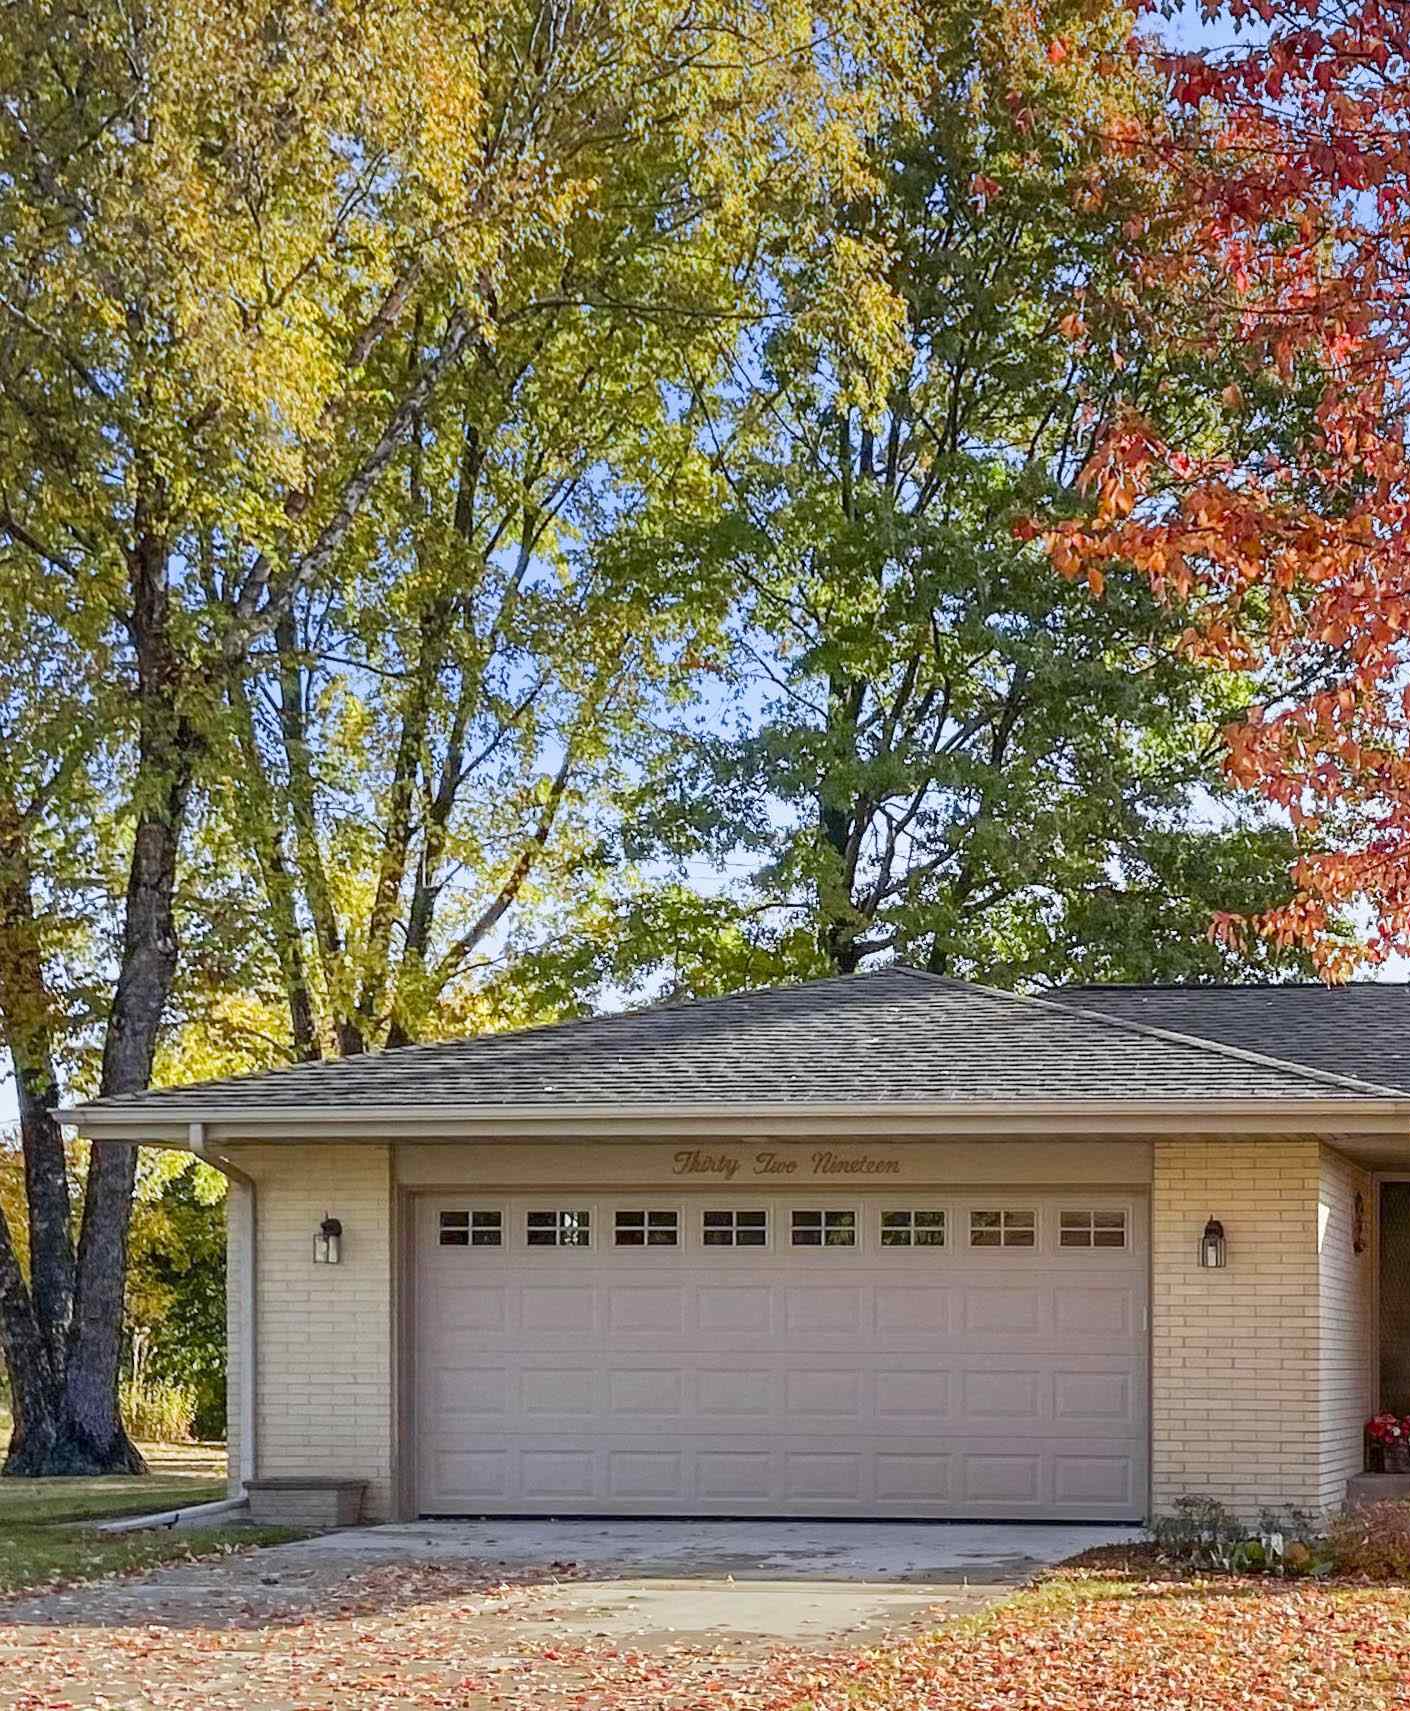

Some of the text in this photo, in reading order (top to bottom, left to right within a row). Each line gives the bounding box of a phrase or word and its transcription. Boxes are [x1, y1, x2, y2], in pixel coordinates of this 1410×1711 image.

[672, 1151, 901, 1181] Thirty Two Nineteen
